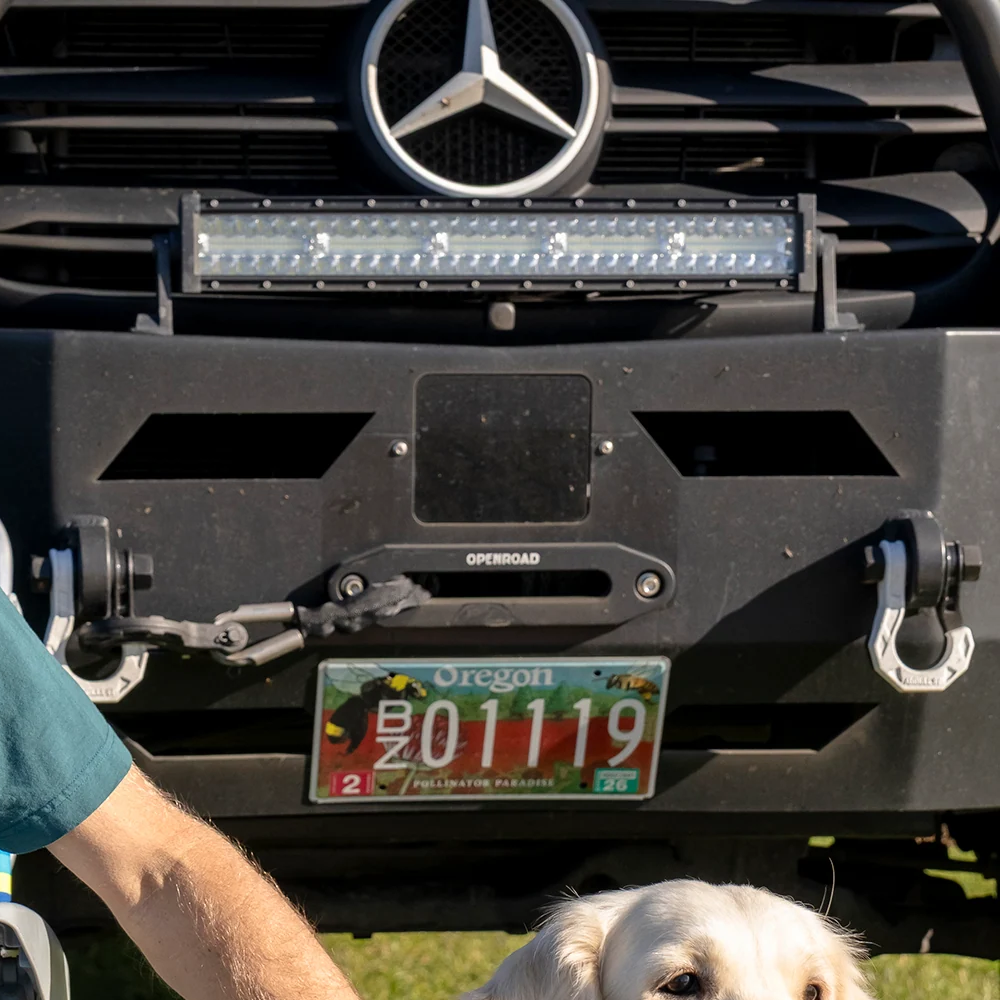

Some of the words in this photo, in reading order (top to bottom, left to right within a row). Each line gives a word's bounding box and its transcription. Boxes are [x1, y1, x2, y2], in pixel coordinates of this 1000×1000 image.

[466, 552, 540, 566] OPENROAD
[433, 665, 554, 693] Oregon
[342, 773, 361, 794] 2
[413, 778, 490, 788] POLLINATOR
[495, 778, 555, 788] PARADISE
[602, 780, 628, 792] 26
